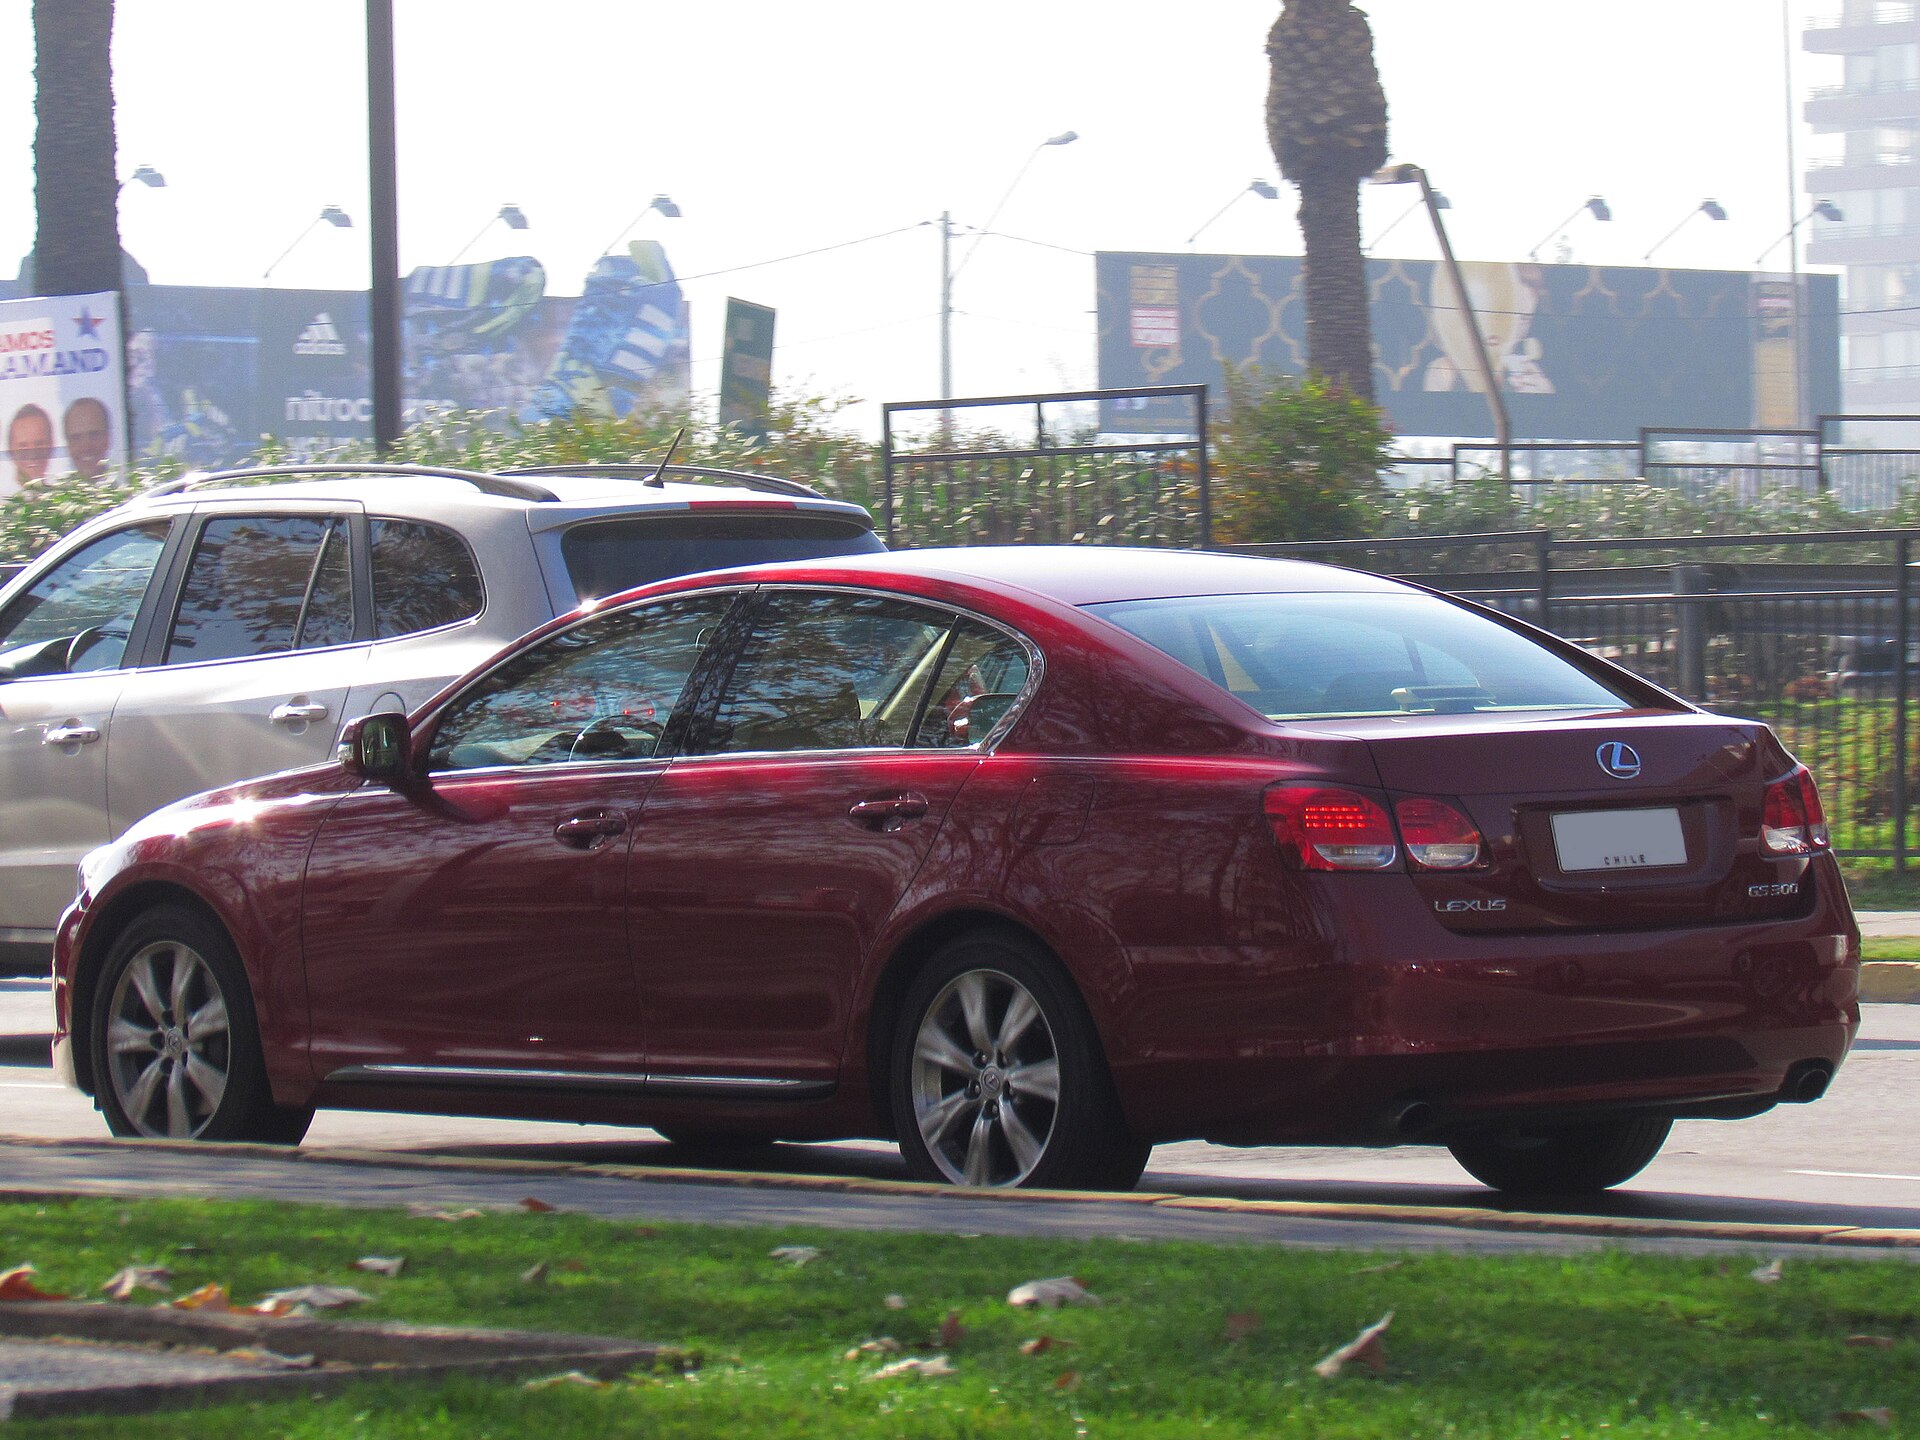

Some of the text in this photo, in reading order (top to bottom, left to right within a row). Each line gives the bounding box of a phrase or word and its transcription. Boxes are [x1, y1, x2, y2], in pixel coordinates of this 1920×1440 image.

[1604, 854, 1646, 865] CHILE
[1748, 883, 1798, 897] GS 300
[1435, 899, 1506, 912] LEXUS
